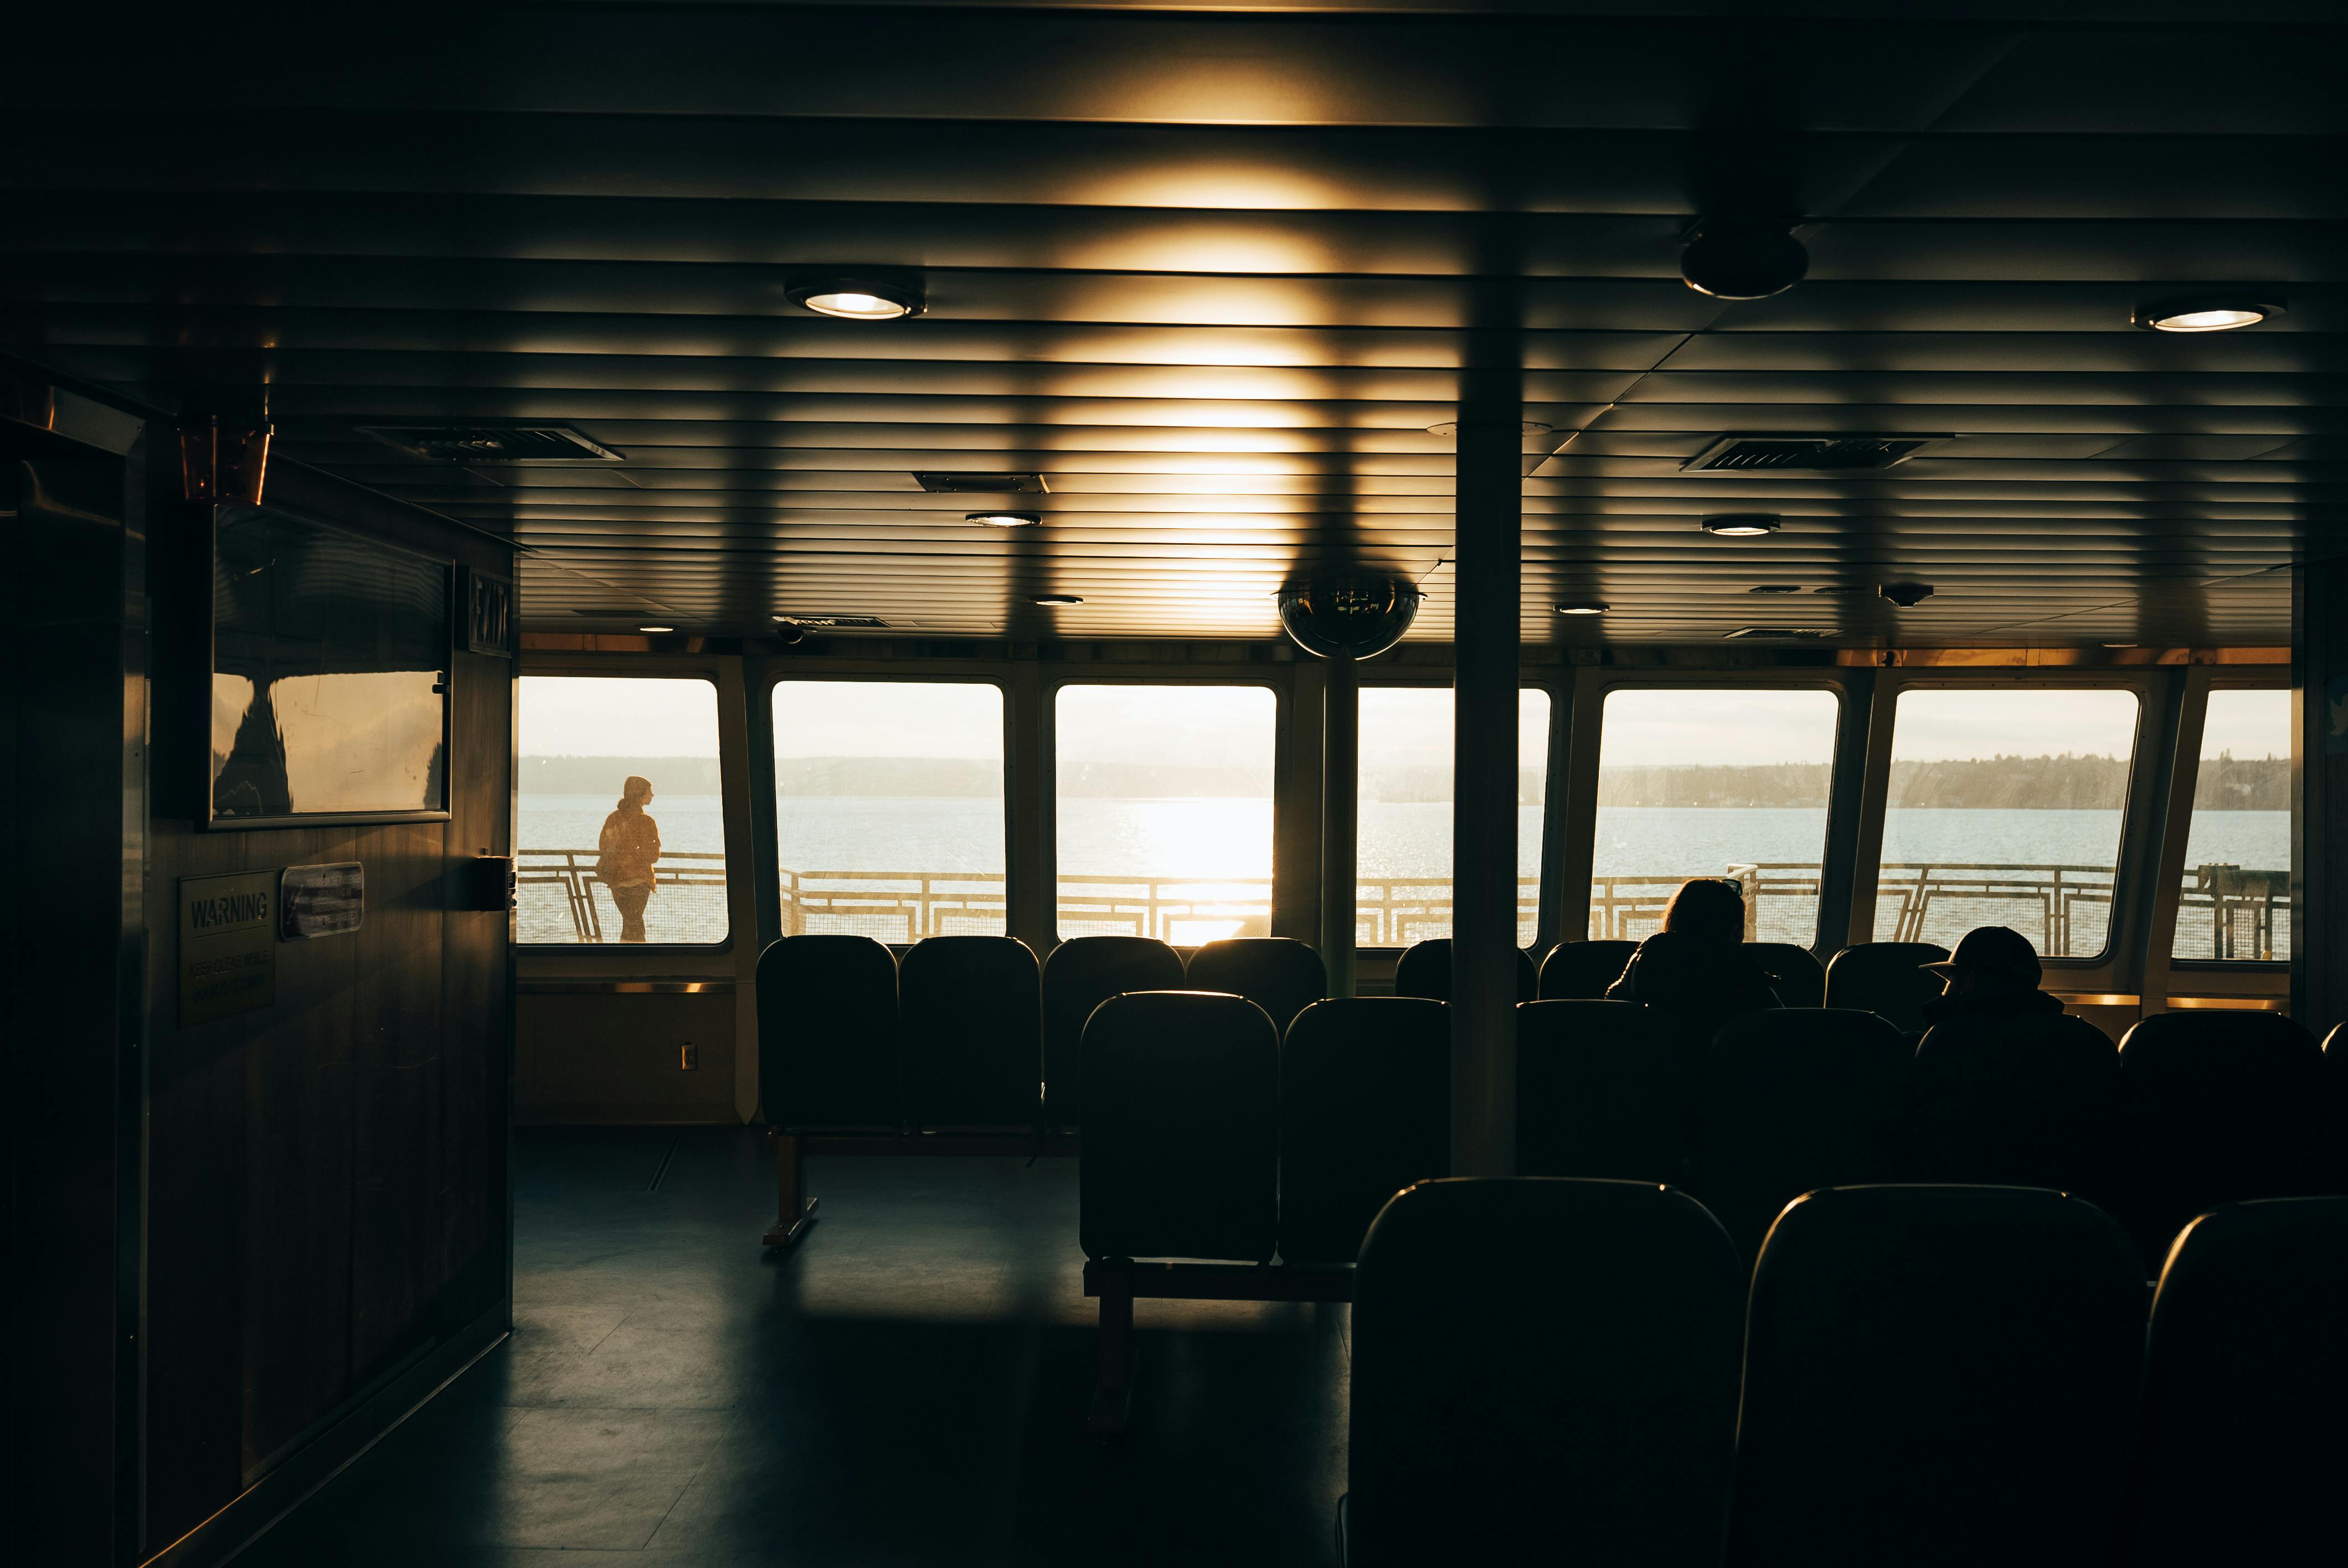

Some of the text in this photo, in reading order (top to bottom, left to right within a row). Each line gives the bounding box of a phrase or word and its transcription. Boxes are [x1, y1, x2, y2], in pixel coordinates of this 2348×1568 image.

[190, 891, 267, 929] WARNING
[189, 949, 268, 978] KEEP CLEAR WHILE
[193, 983, 218, 1003] DOOR
[229, 973, 265, 995] CLOSING
